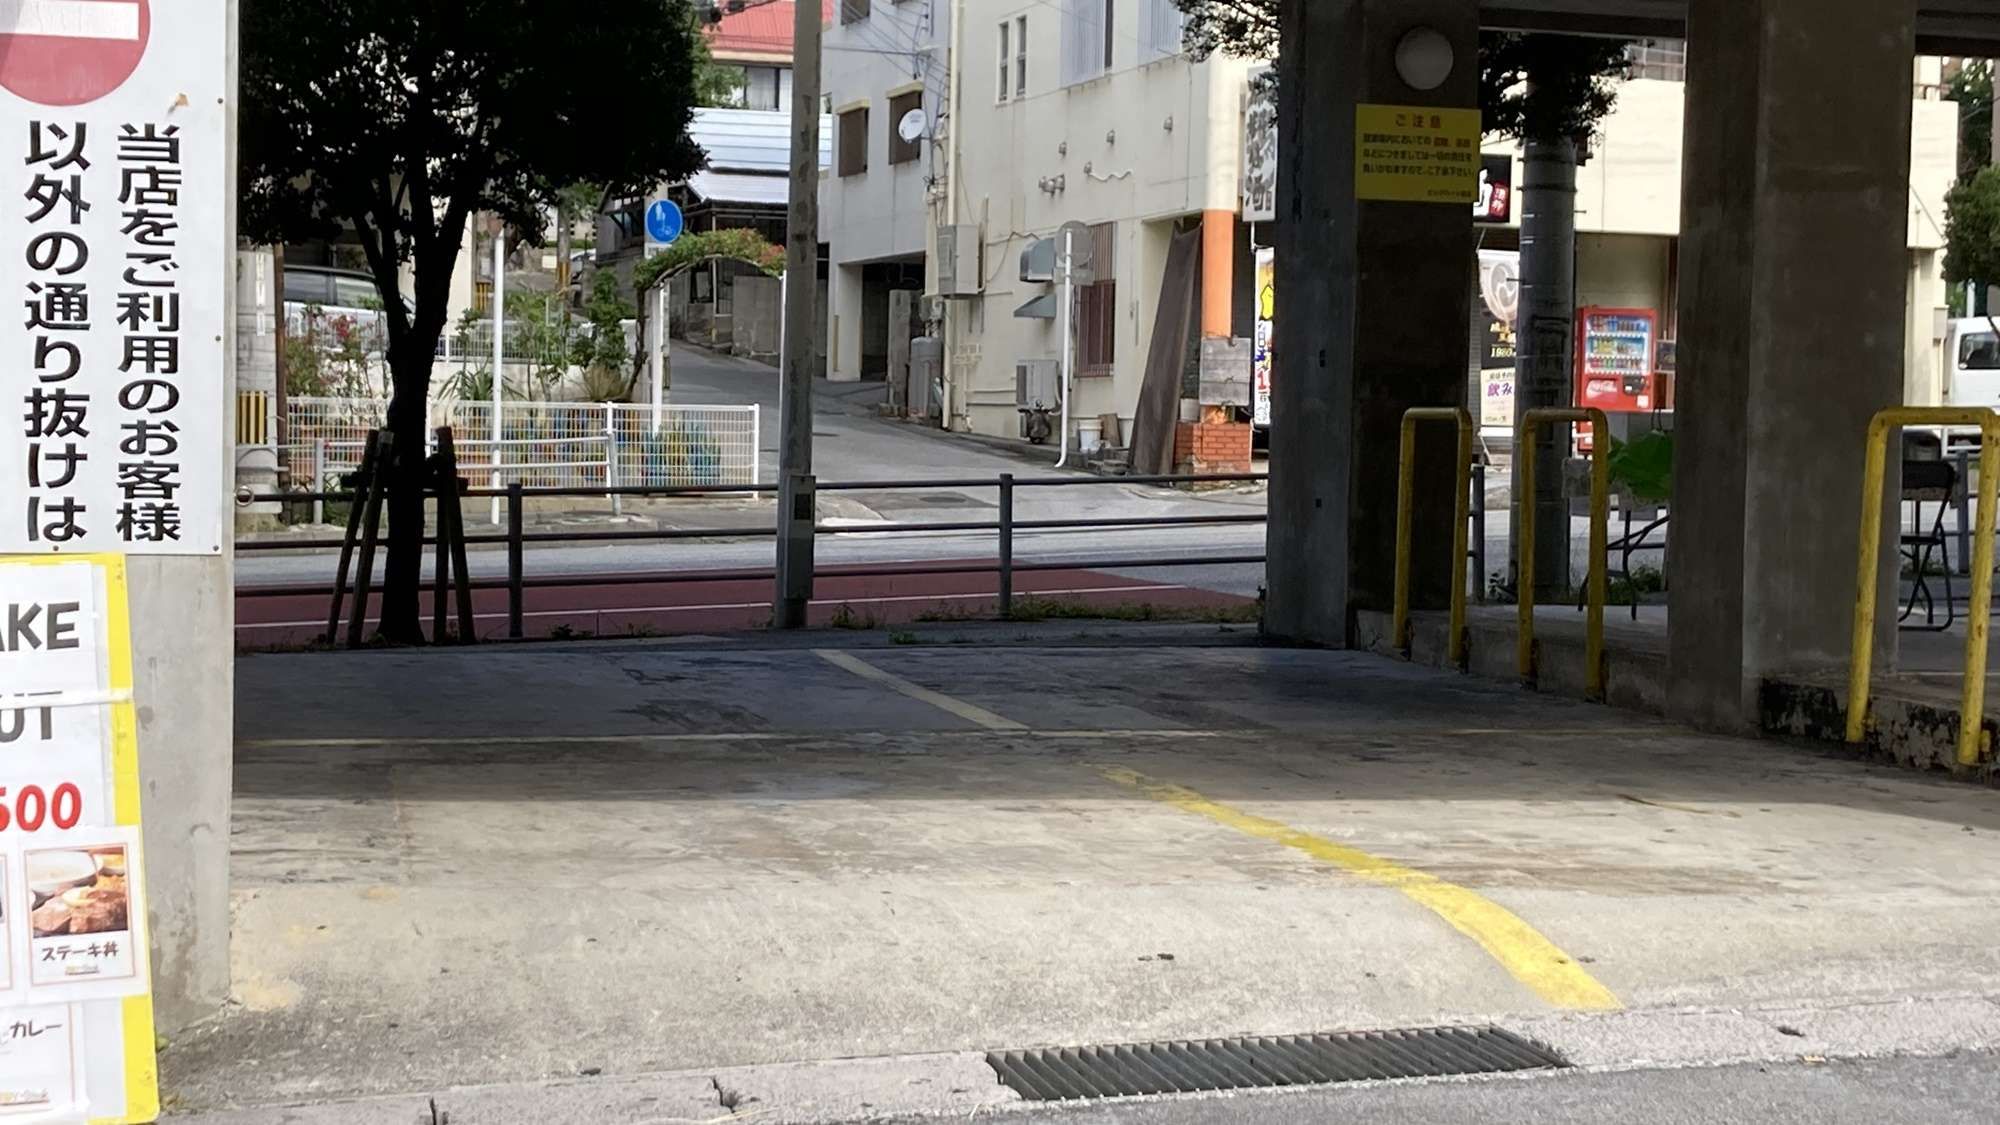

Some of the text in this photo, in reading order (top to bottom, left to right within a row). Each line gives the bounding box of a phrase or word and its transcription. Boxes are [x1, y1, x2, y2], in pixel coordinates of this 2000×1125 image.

[24, 120, 92, 543] 以外の通り抜けは
[116, 122, 182, 542] 当店をご利用のお客様
[0, 601, 80, 651] KE
[41, 940, 120, 962] ステーキ丼
